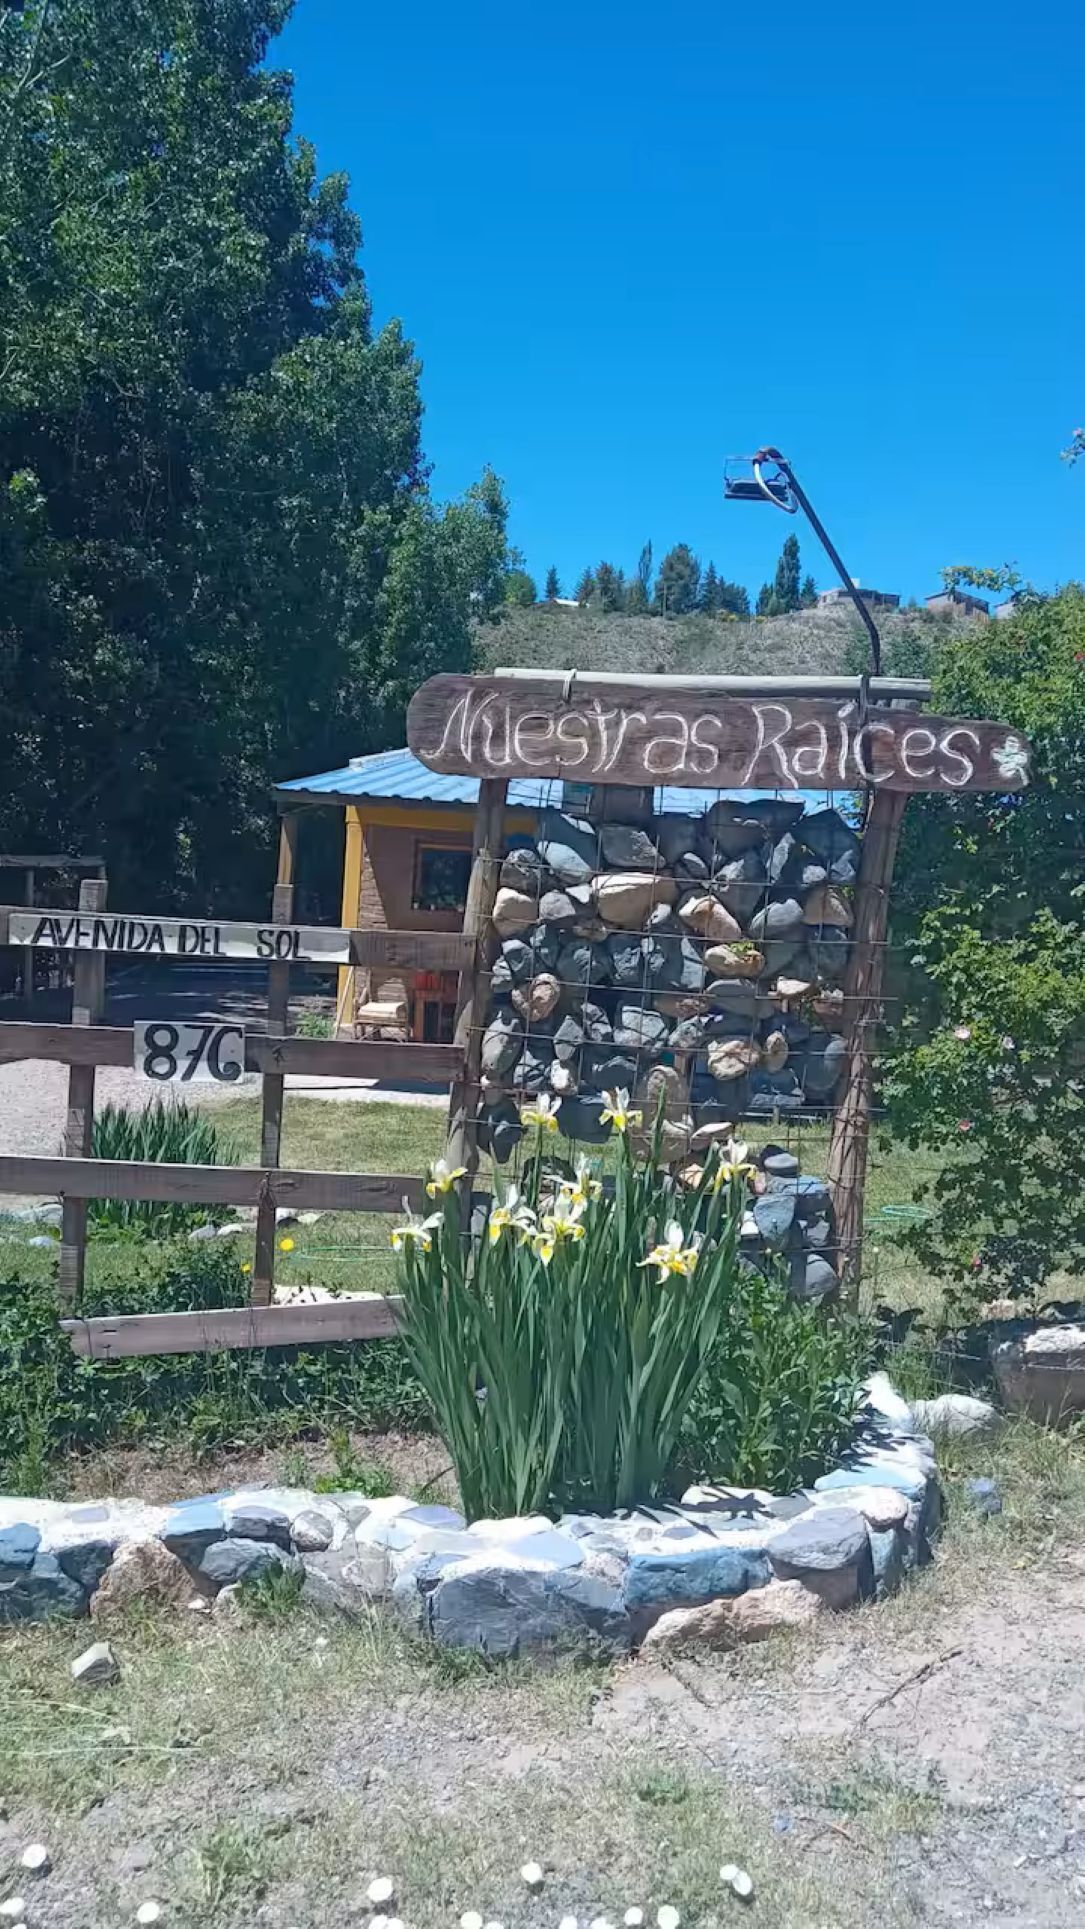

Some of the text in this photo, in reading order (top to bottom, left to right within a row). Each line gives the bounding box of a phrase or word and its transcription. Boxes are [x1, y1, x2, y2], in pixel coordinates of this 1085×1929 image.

[419, 687, 722, 774] Nuestras
[30, 917, 312, 960] AVENIDA DEL SOL
